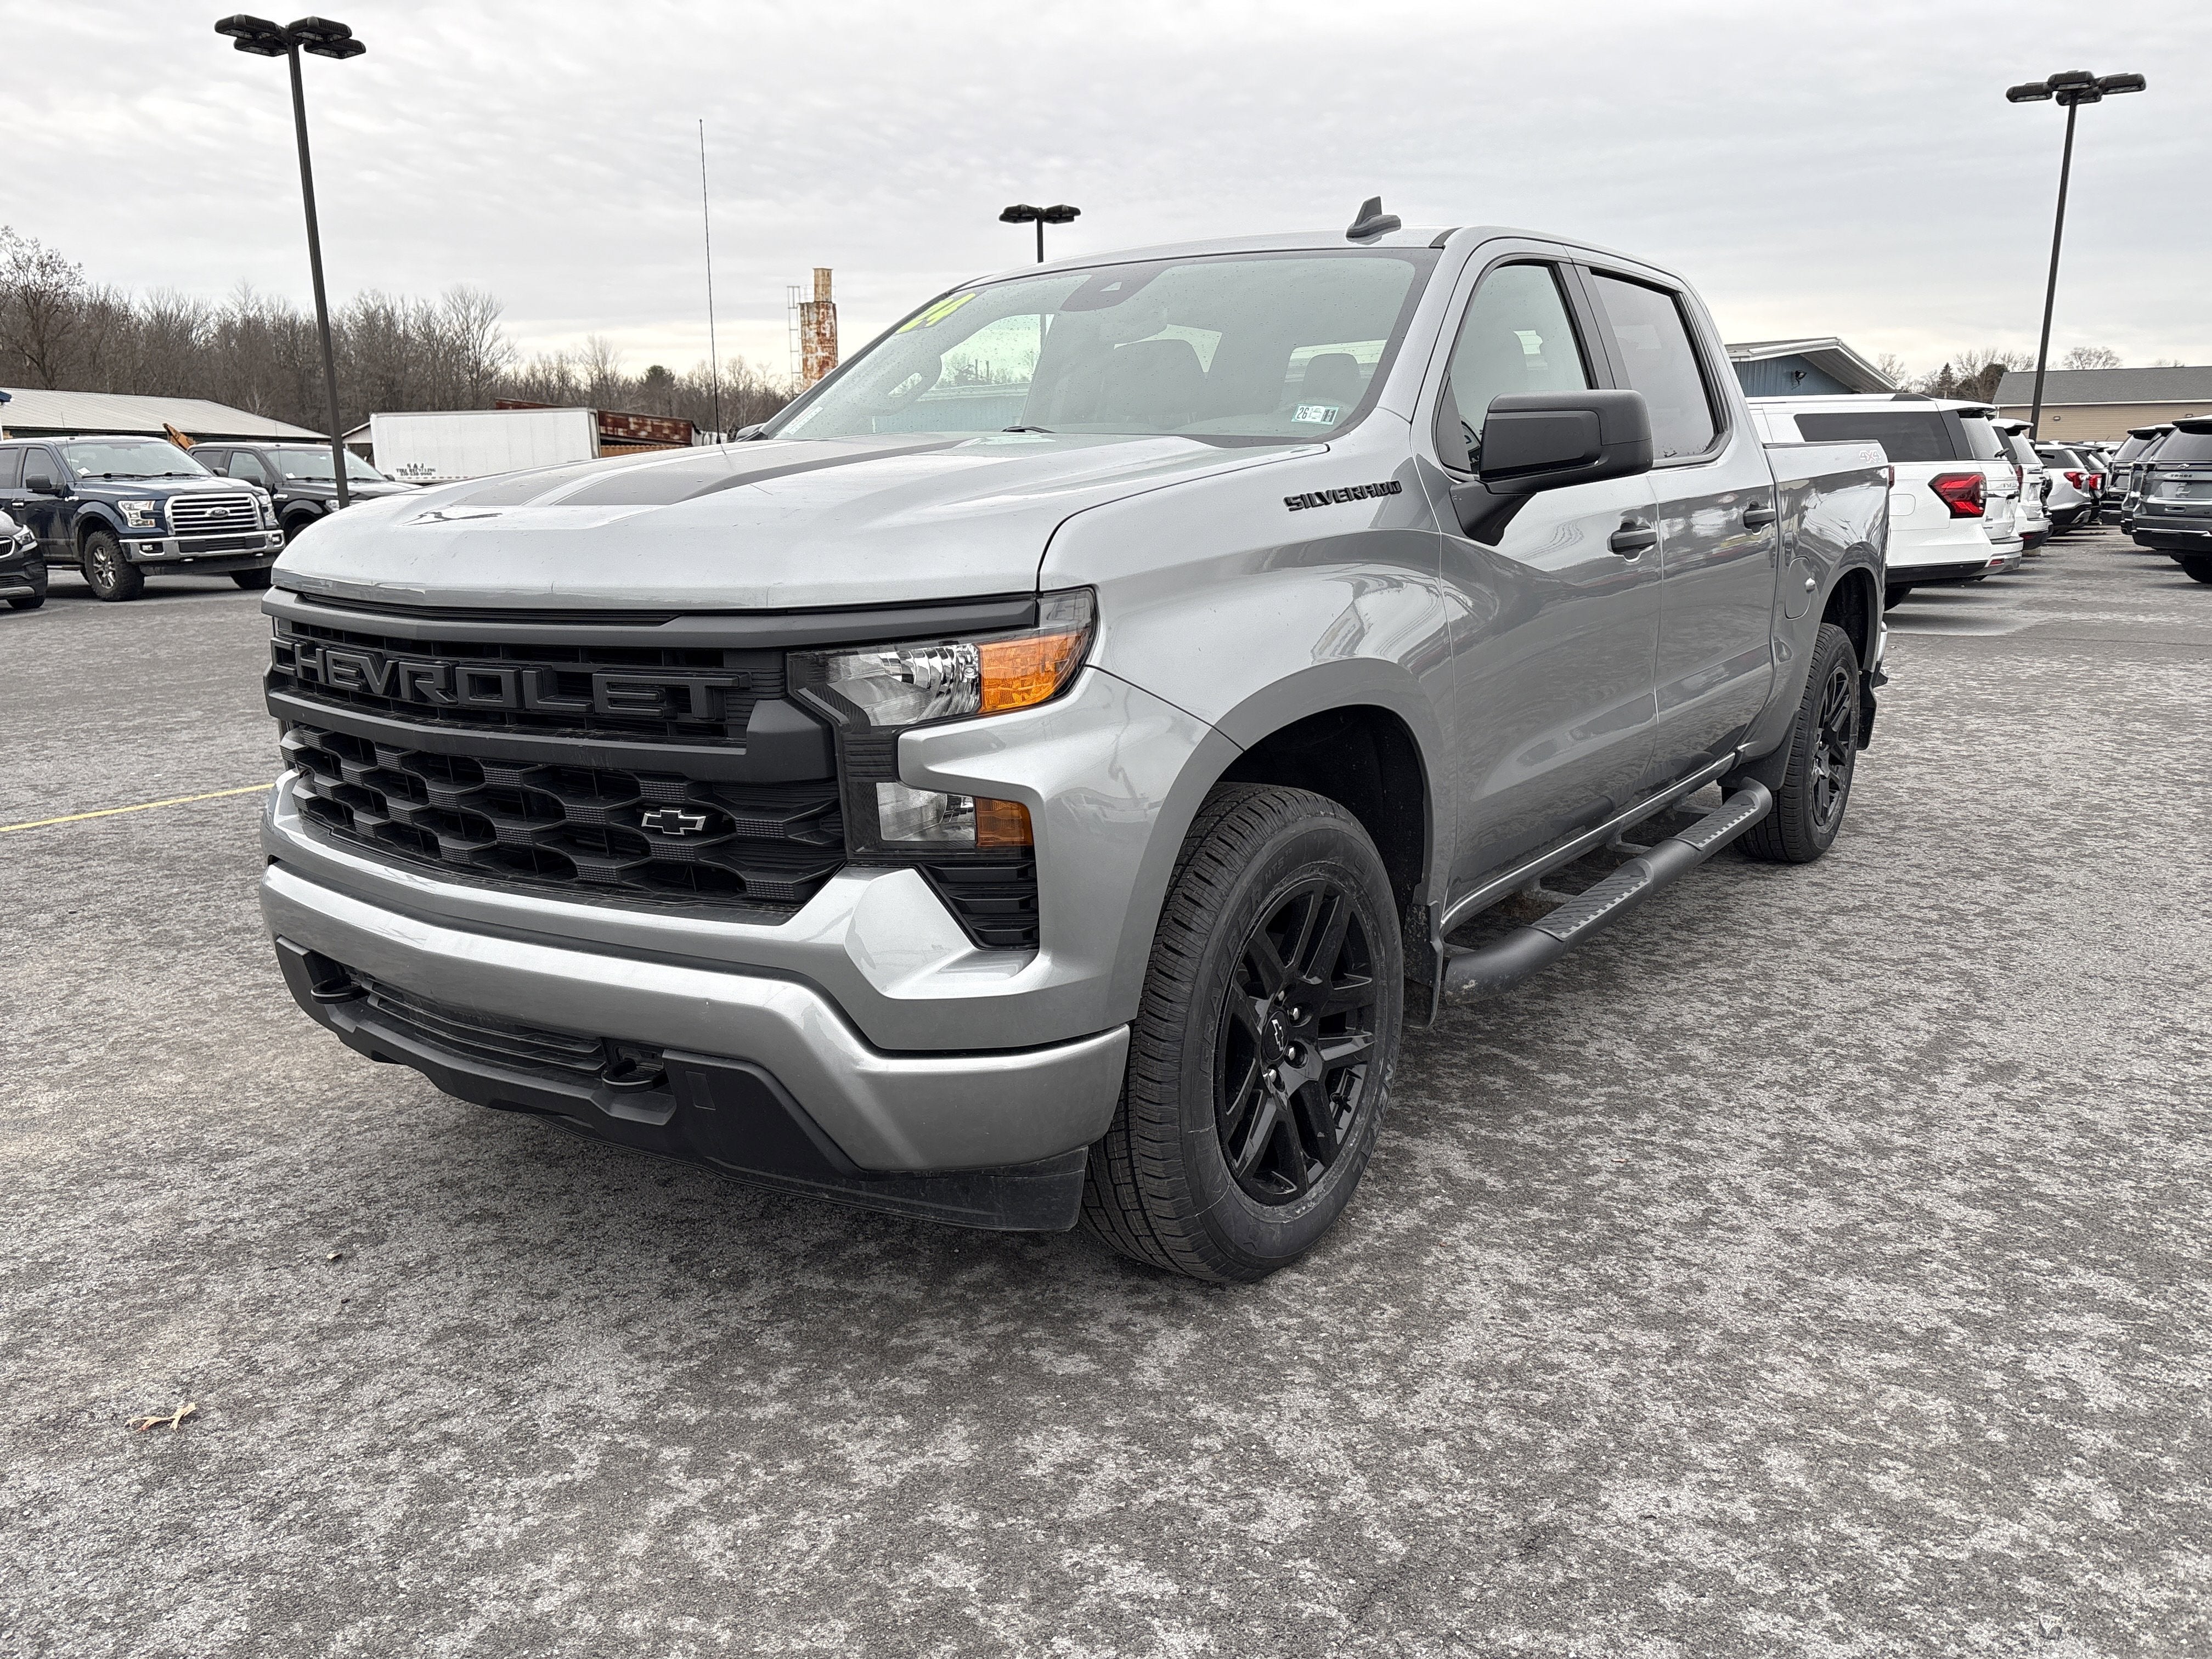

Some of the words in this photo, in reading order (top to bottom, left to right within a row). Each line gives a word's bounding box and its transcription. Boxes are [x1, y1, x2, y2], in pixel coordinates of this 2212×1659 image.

[1296, 407, 1310, 419] 26
[1323, 409, 1336, 422] 11
[1283, 480, 1403, 512] SILVERADO
[270, 636, 748, 720] CHEVROLET
